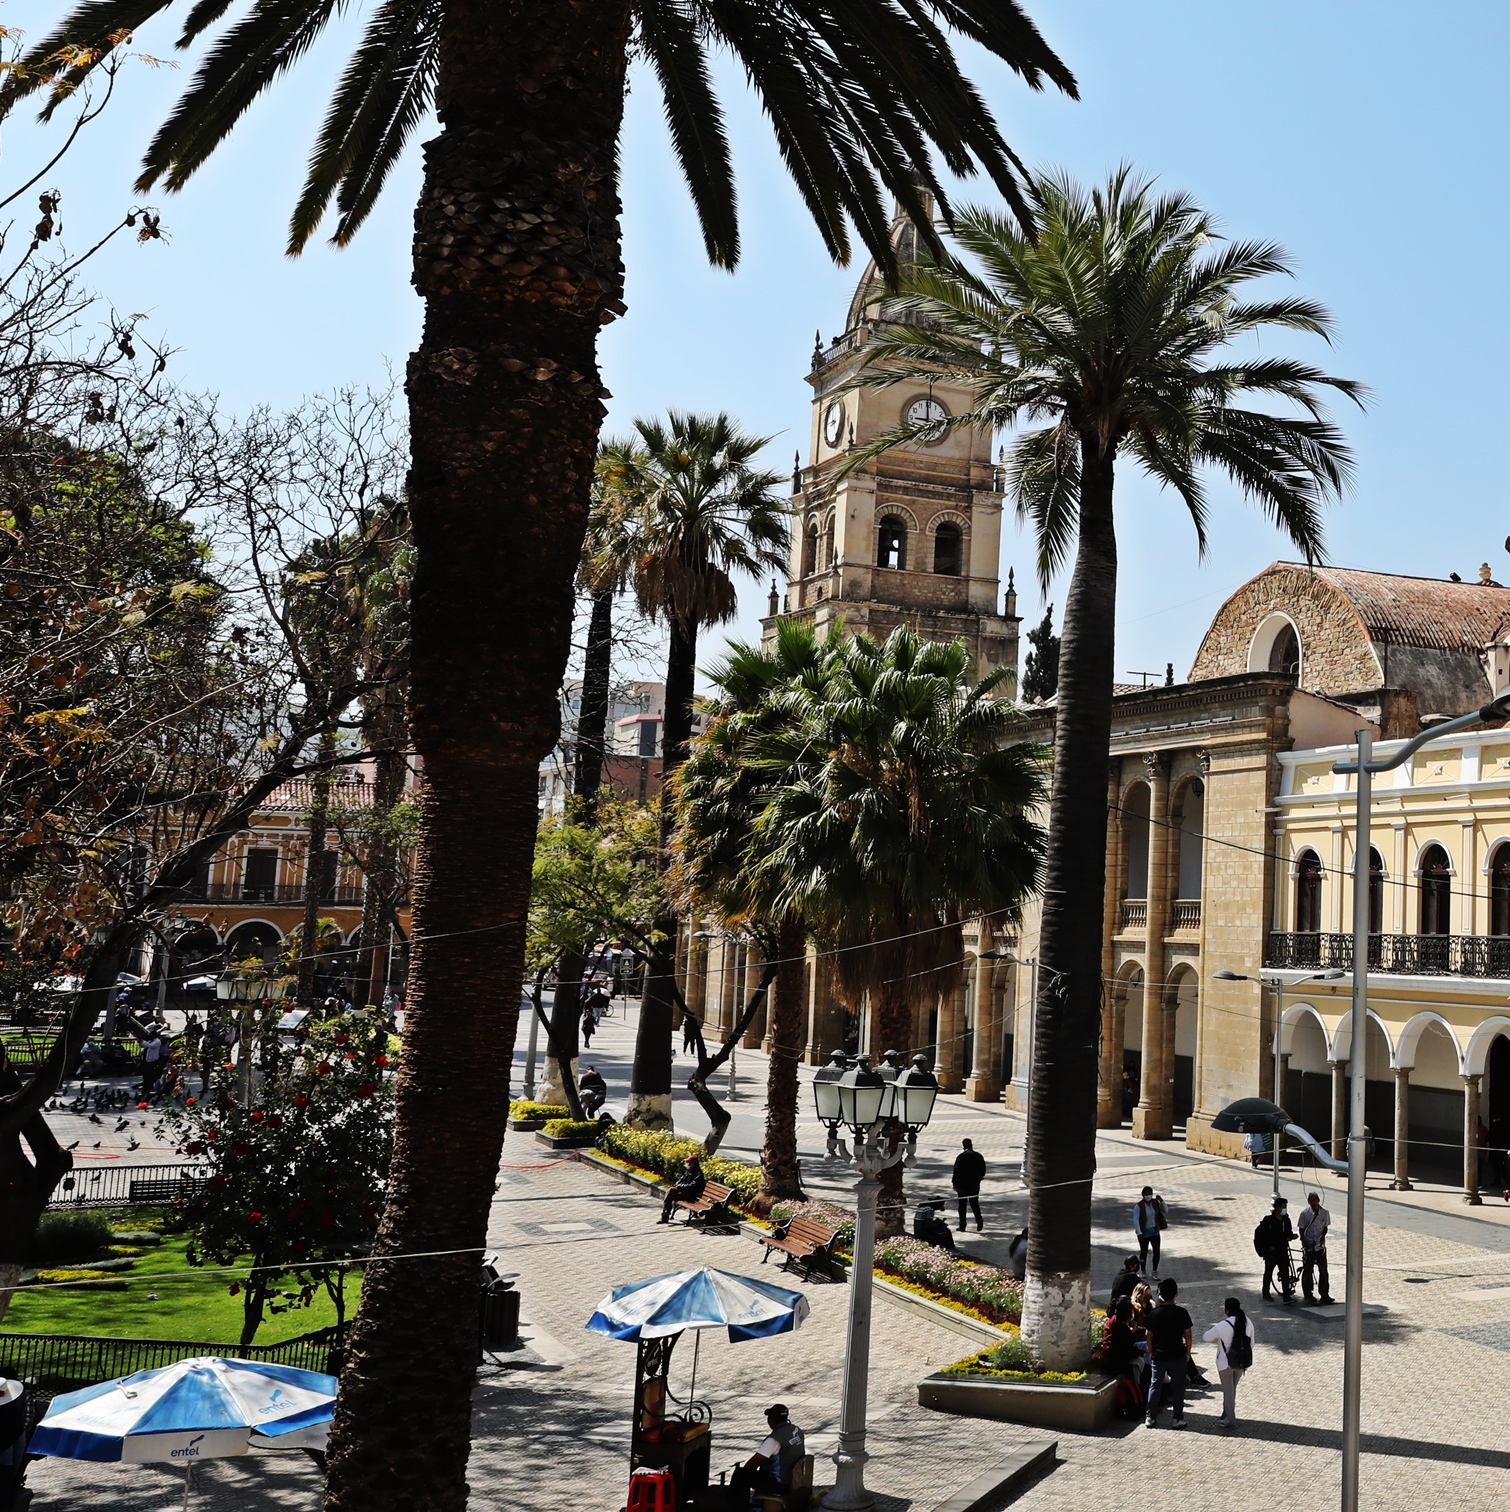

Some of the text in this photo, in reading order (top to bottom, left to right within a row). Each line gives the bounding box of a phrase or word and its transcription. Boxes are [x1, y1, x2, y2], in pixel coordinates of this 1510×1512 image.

[738, 1308, 767, 1320] entel
[258, 1399, 297, 1415] entel
[170, 1446, 200, 1458] entel
